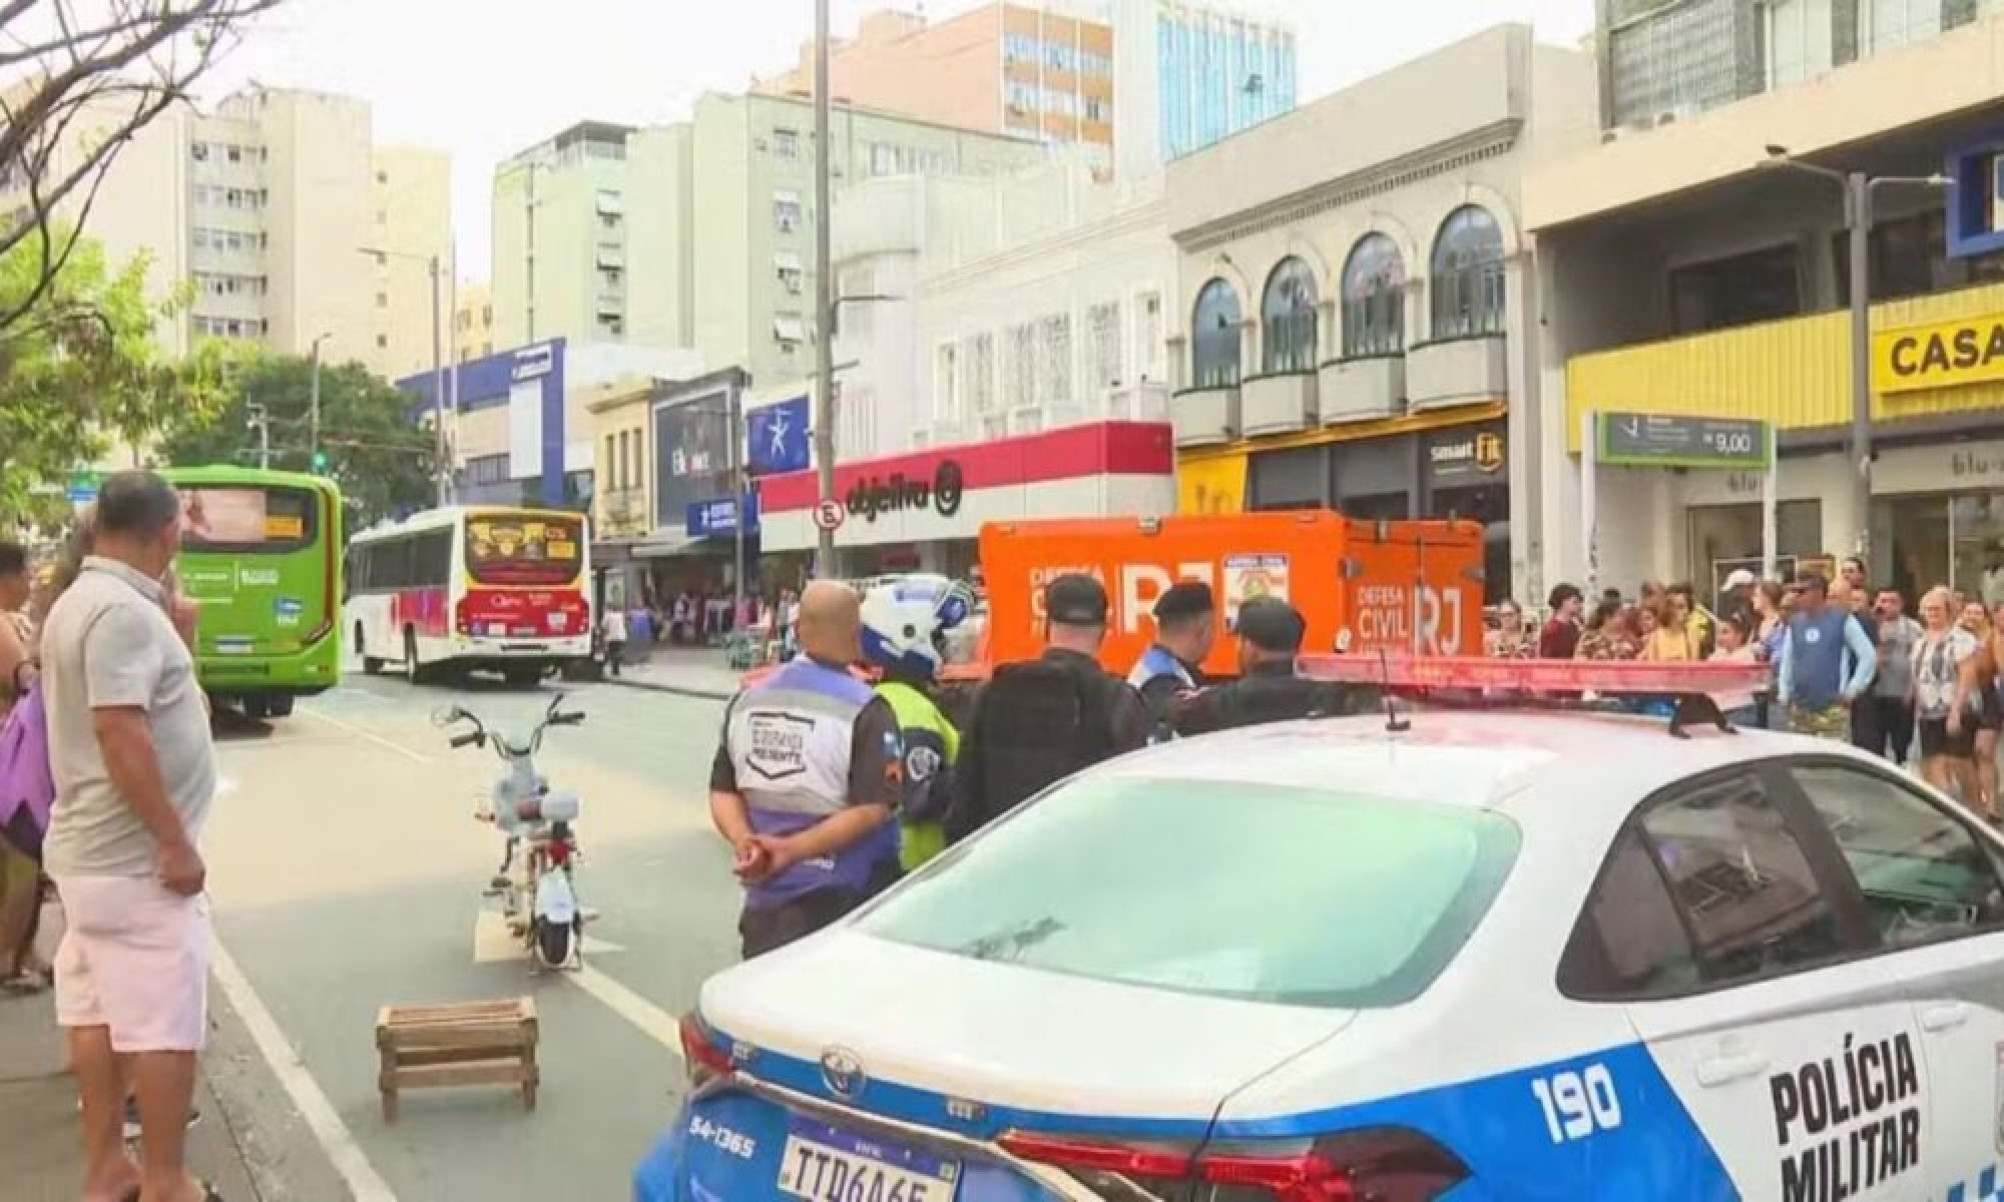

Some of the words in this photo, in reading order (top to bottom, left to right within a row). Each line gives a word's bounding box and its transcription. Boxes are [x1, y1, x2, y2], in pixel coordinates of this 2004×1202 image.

[1715, 432, 1751, 454] 9,00
[1359, 607, 1408, 638] CIVIL
[1414, 585, 1460, 658] RJ
[1531, 1062, 1622, 1144] 190
[1769, 1032, 1918, 1145] POLÍCIA
[1780, 1106, 1920, 1202] MILITAR
